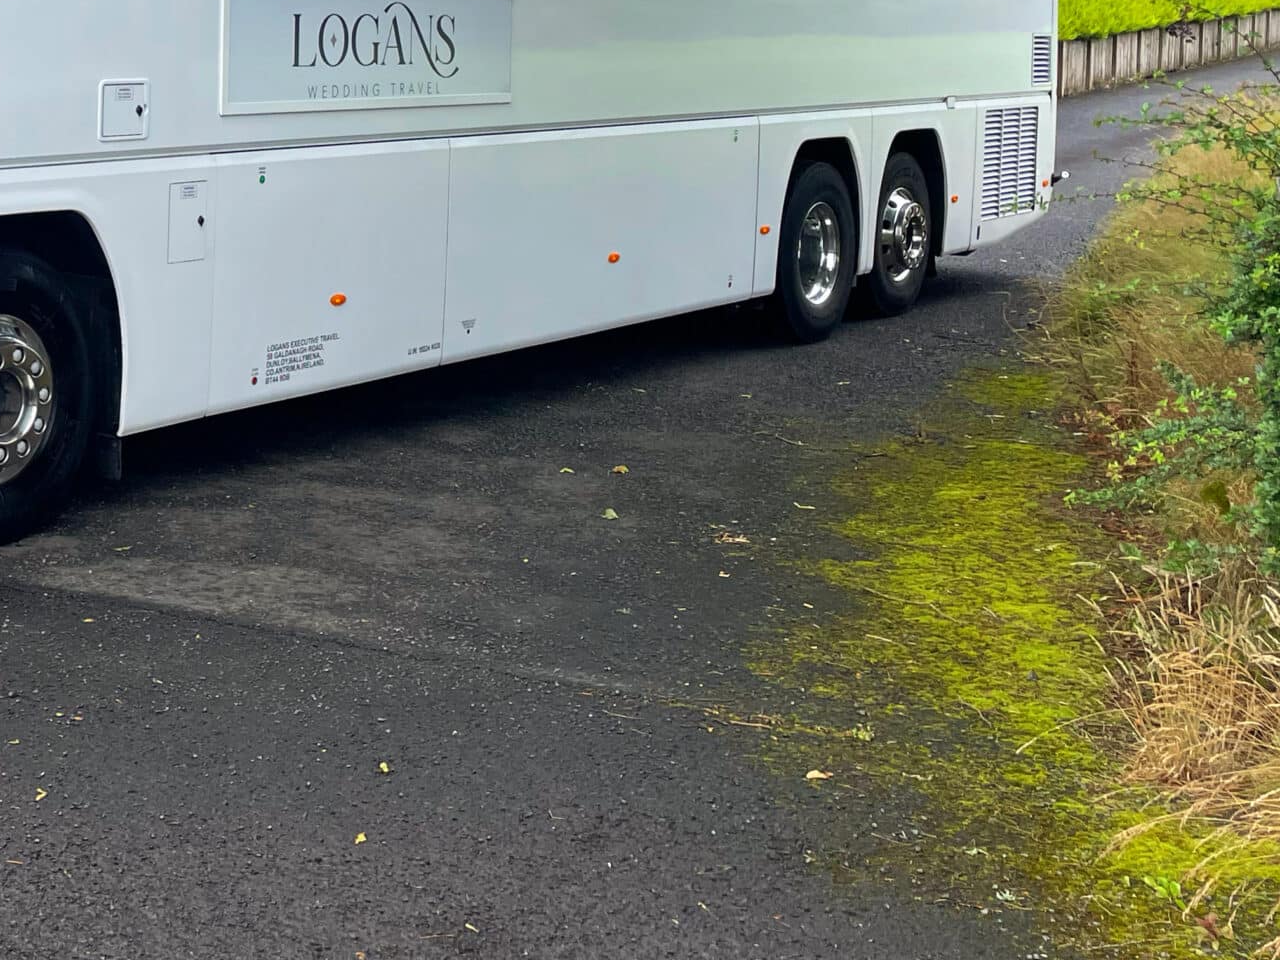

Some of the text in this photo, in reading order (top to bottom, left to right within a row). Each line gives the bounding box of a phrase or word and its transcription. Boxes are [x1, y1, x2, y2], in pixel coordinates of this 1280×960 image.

[291, 1, 459, 78] LOGANS
[307, 82, 440, 99] WEDDING TRAVEL
[266, 341, 290, 353] LOGANS
